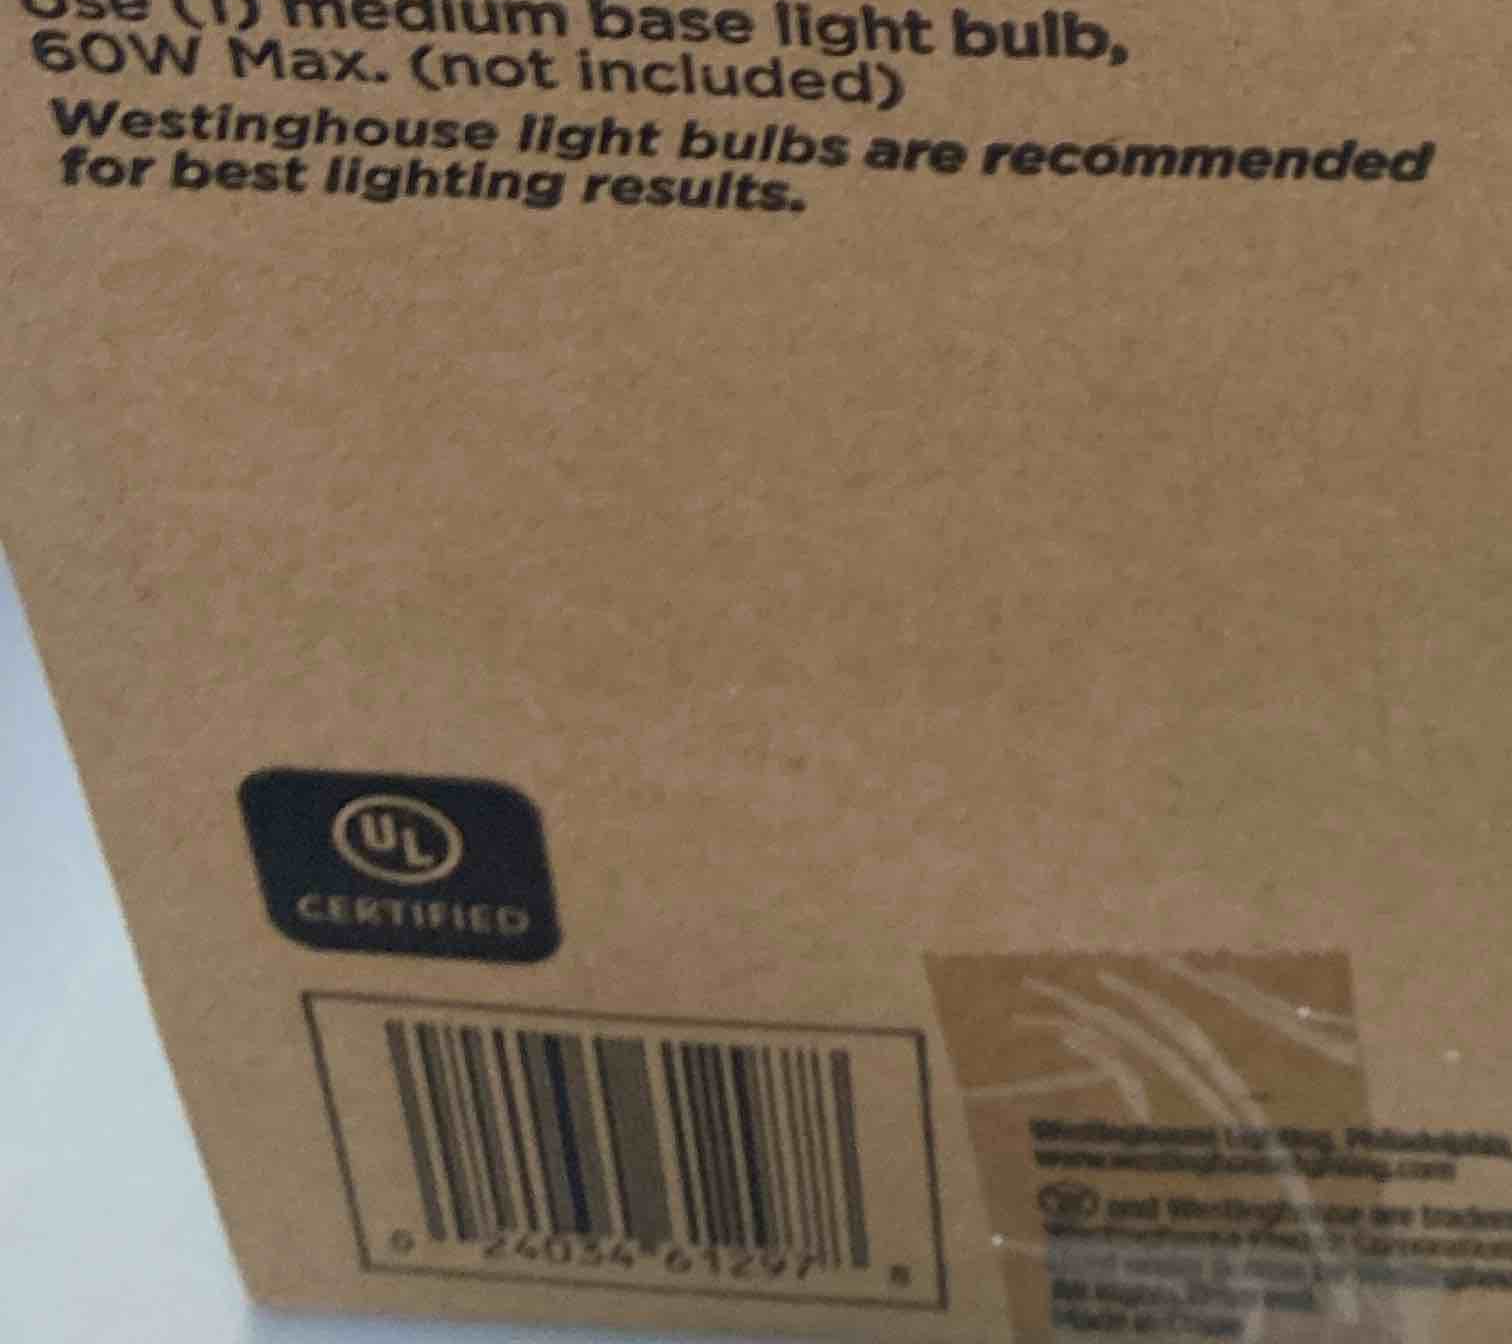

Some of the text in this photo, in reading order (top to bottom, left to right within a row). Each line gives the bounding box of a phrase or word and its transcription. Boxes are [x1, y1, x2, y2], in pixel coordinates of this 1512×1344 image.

[775, 0, 933, 58] light
[952, 8, 1129, 69] bulb,
[29, 31, 907, 112] 60W Max. (not included)
[49, 97, 1433, 186] Westinghouse light bulbs are recommended
[59, 147, 806, 214] for best lighting results.
[297, 893, 530, 935] CERTIFIED
